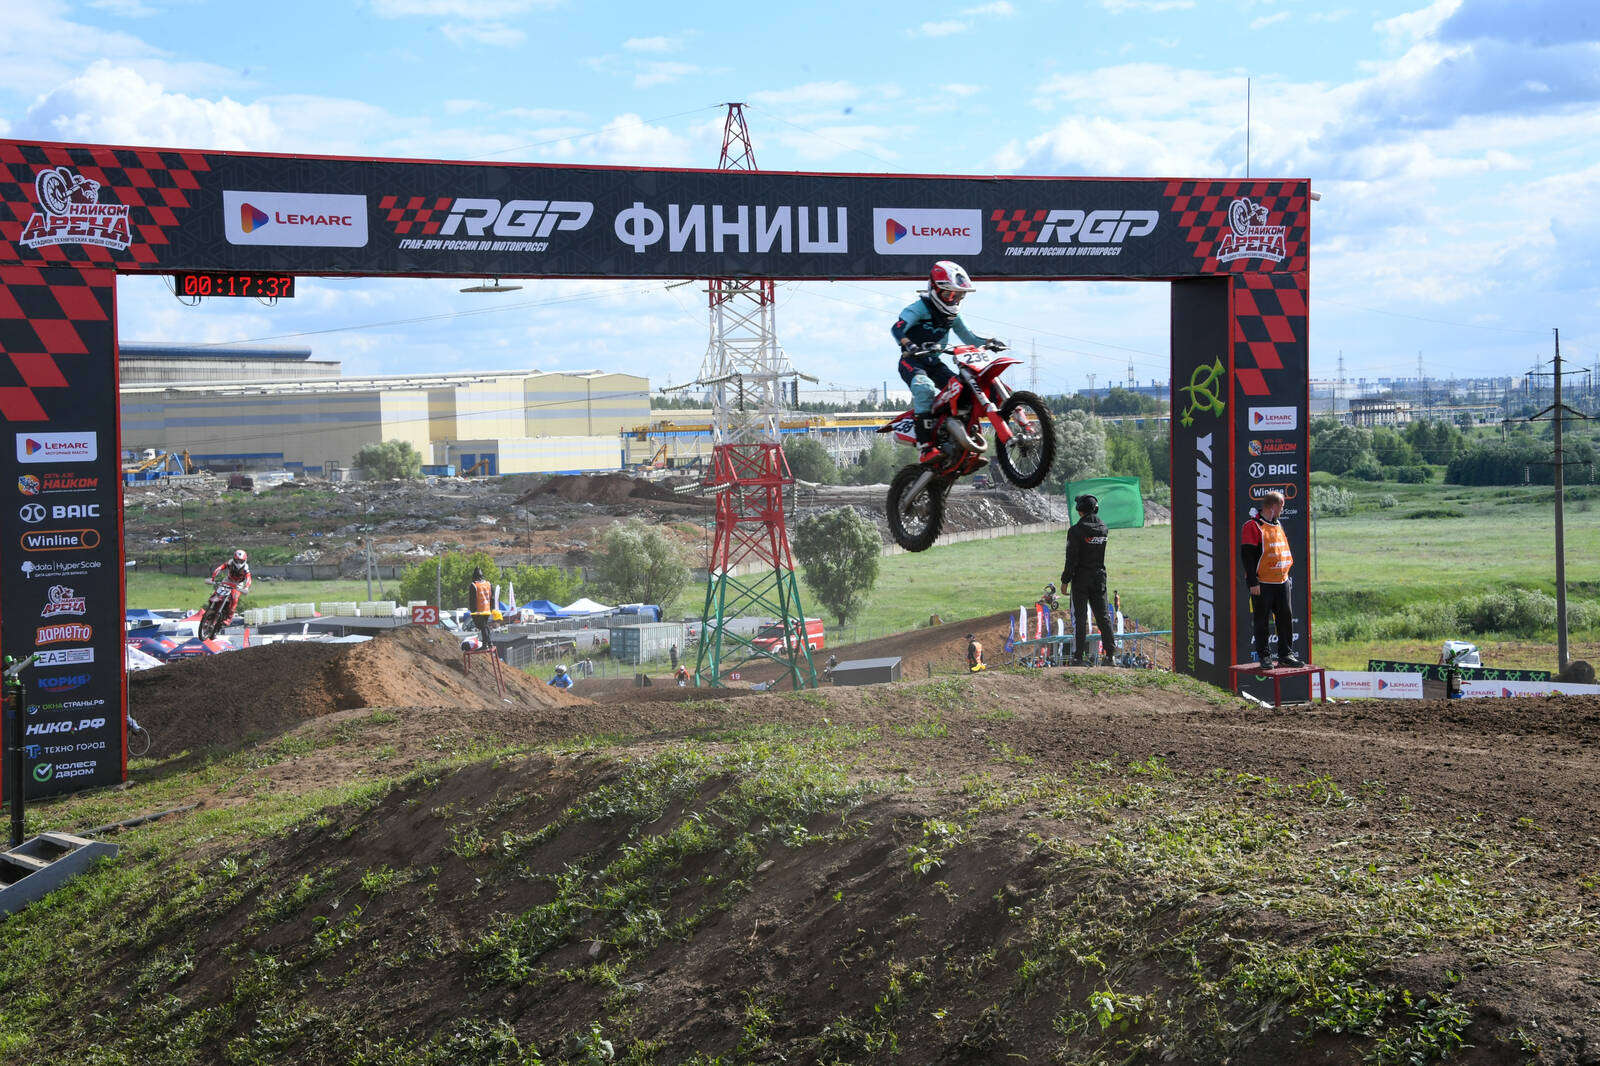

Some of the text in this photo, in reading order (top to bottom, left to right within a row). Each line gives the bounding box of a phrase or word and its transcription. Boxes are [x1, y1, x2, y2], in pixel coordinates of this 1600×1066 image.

[275, 211, 352, 226] LEMARC
[440, 198, 594, 237] RGP
[23, 215, 130, 243] АРЕНА
[614, 201, 848, 254] ФИНИШ
[912, 225, 971, 237] LEMARC
[1036, 209, 1160, 243] RGP
[399, 239, 548, 252] ГРАН-ПРИ РОССИИ ПО МОТОКРОССУ
[1005, 247, 1122, 256] ГРАН-ПРИ РОССИИ ПО МОТОКРОССУ
[1219, 236, 1284, 256] АРЕНА
[184, 275, 291, 297] 00:17:37
[1268, 464, 1297, 474] BAIC
[52, 504, 100, 518] BAIC
[28, 534, 78, 547] Winline
[1196, 432, 1215, 665] YAKHNICH
[43, 602, 85, 614] АРЕНА
[415, 608, 436, 622] 23
[1186, 582, 1195, 672] MOTORSPORT
[44, 741, 106, 754] ТЕХНО ГОРОД
